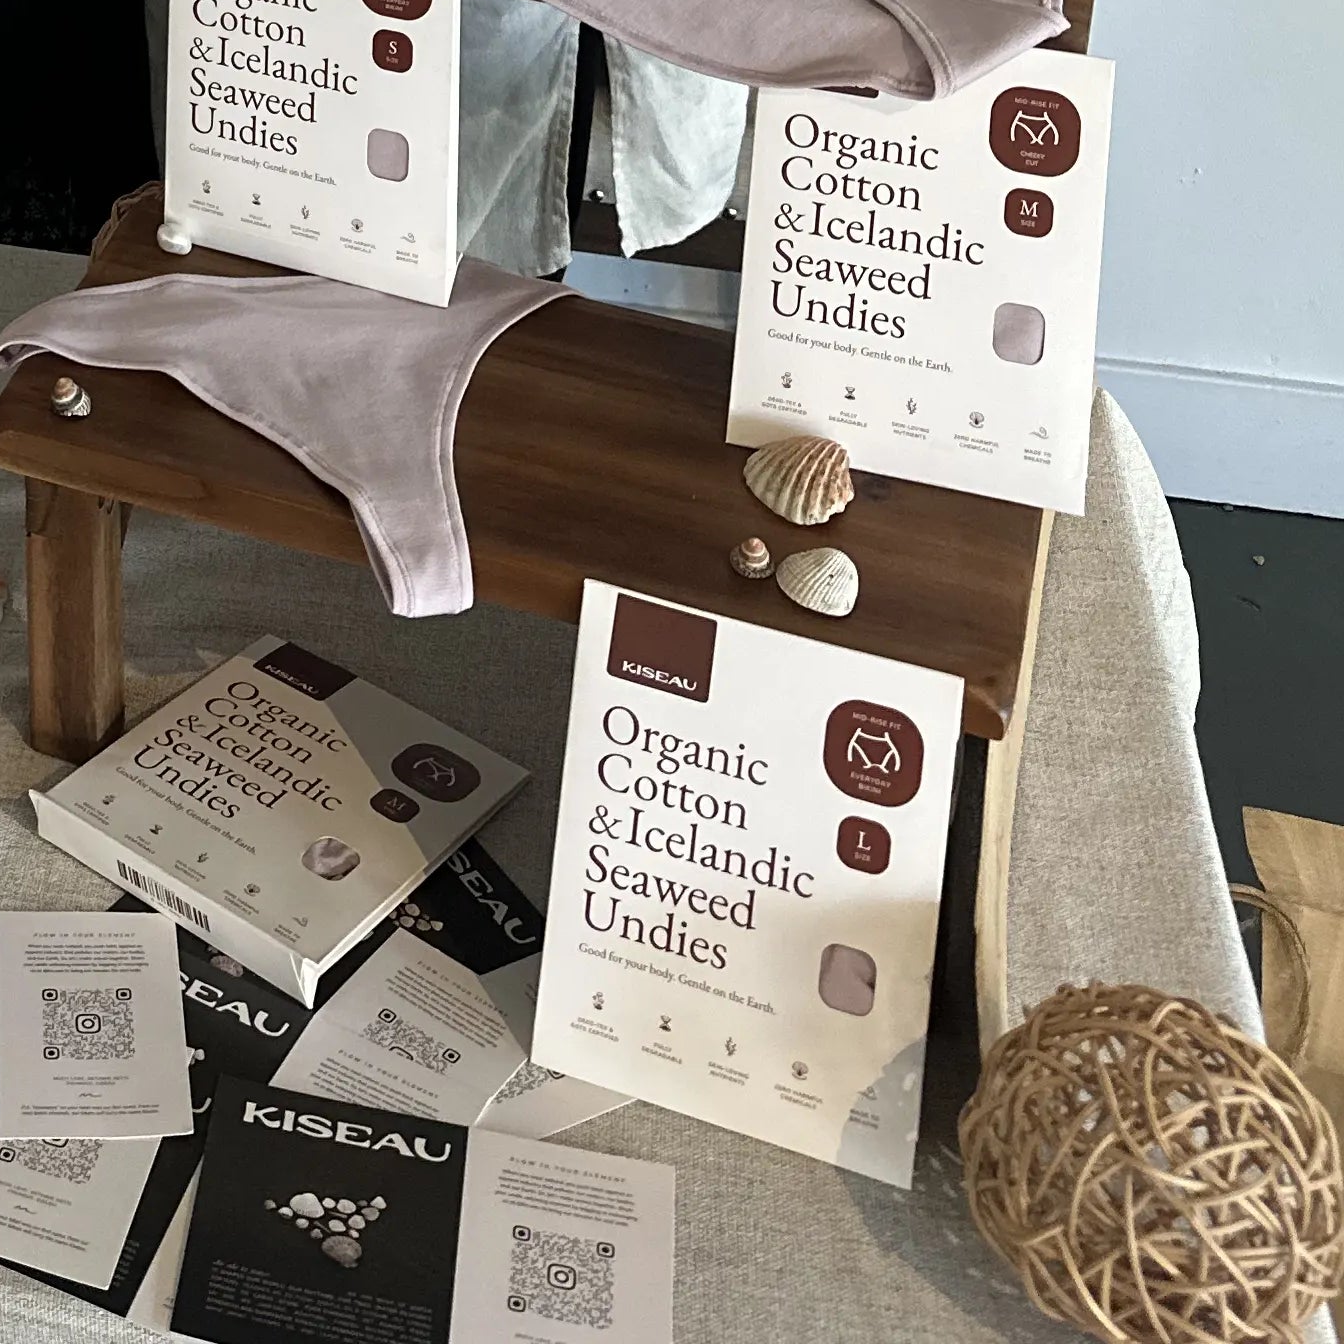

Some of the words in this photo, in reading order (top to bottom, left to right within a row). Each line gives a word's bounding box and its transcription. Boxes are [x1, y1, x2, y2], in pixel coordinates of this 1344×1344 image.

[388, 40, 397, 55] S
[189, 67, 317, 123] Seaweed
[189, 101, 298, 156] Undies
[784, 113, 939, 171] Organic
[781, 155, 922, 212] Cotton
[1019, 199, 1039, 218] M
[772, 238, 931, 300] Seaweed
[770, 279, 906, 339] Undies
[767, 328, 794, 342] Good
[795, 333, 809, 345] for
[809, 339, 832, 350] your
[860, 346, 892, 361] Gentle
[893, 355, 906, 365] on
[908, 355, 923, 368] the
[925, 358, 951, 373] Earth.
[622, 660, 697, 691] KISEAU
[204, 697, 312, 764] Cotton
[227, 681, 347, 752] Organic
[602, 705, 769, 786] Organic
[134, 744, 241, 819] Undies
[154, 728, 288, 809] Seaweed
[597, 753, 747, 831] Cotton
[116, 765, 138, 784] Good
[146, 781, 166, 800] your
[186, 807, 210, 827] Gentle
[220, 825, 237, 841] the
[234, 836, 257, 856] Earth.
[857, 830, 871, 851] L
[585, 844, 756, 930] Seaweed
[583, 888, 727, 970] Undies
[578, 942, 607, 960] Good
[608, 950, 624, 964] for
[624, 958, 649, 972] your
[677, 973, 712, 993] Gentle
[712, 987, 727, 999] on
[728, 990, 745, 1005] the
[746, 995, 776, 1016] Earth.
[242, 1100, 452, 1163] KISEAU
